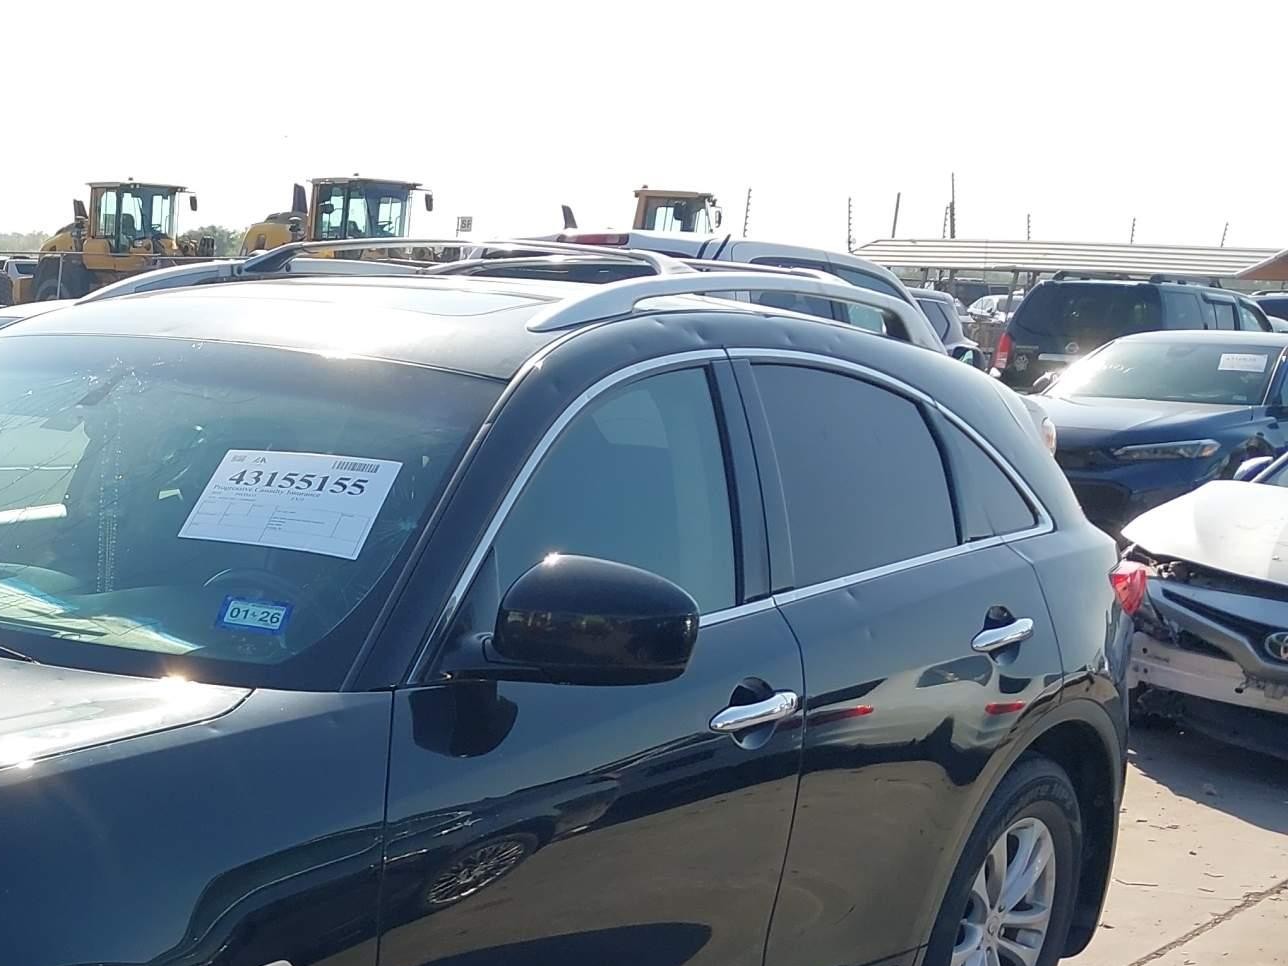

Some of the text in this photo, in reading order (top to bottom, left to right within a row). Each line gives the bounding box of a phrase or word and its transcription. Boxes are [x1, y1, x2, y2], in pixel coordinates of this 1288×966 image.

[212, 484, 253, 493] Progressive
[228, 469, 370, 496] 43155155
[230, 607, 281, 624] 01 26
